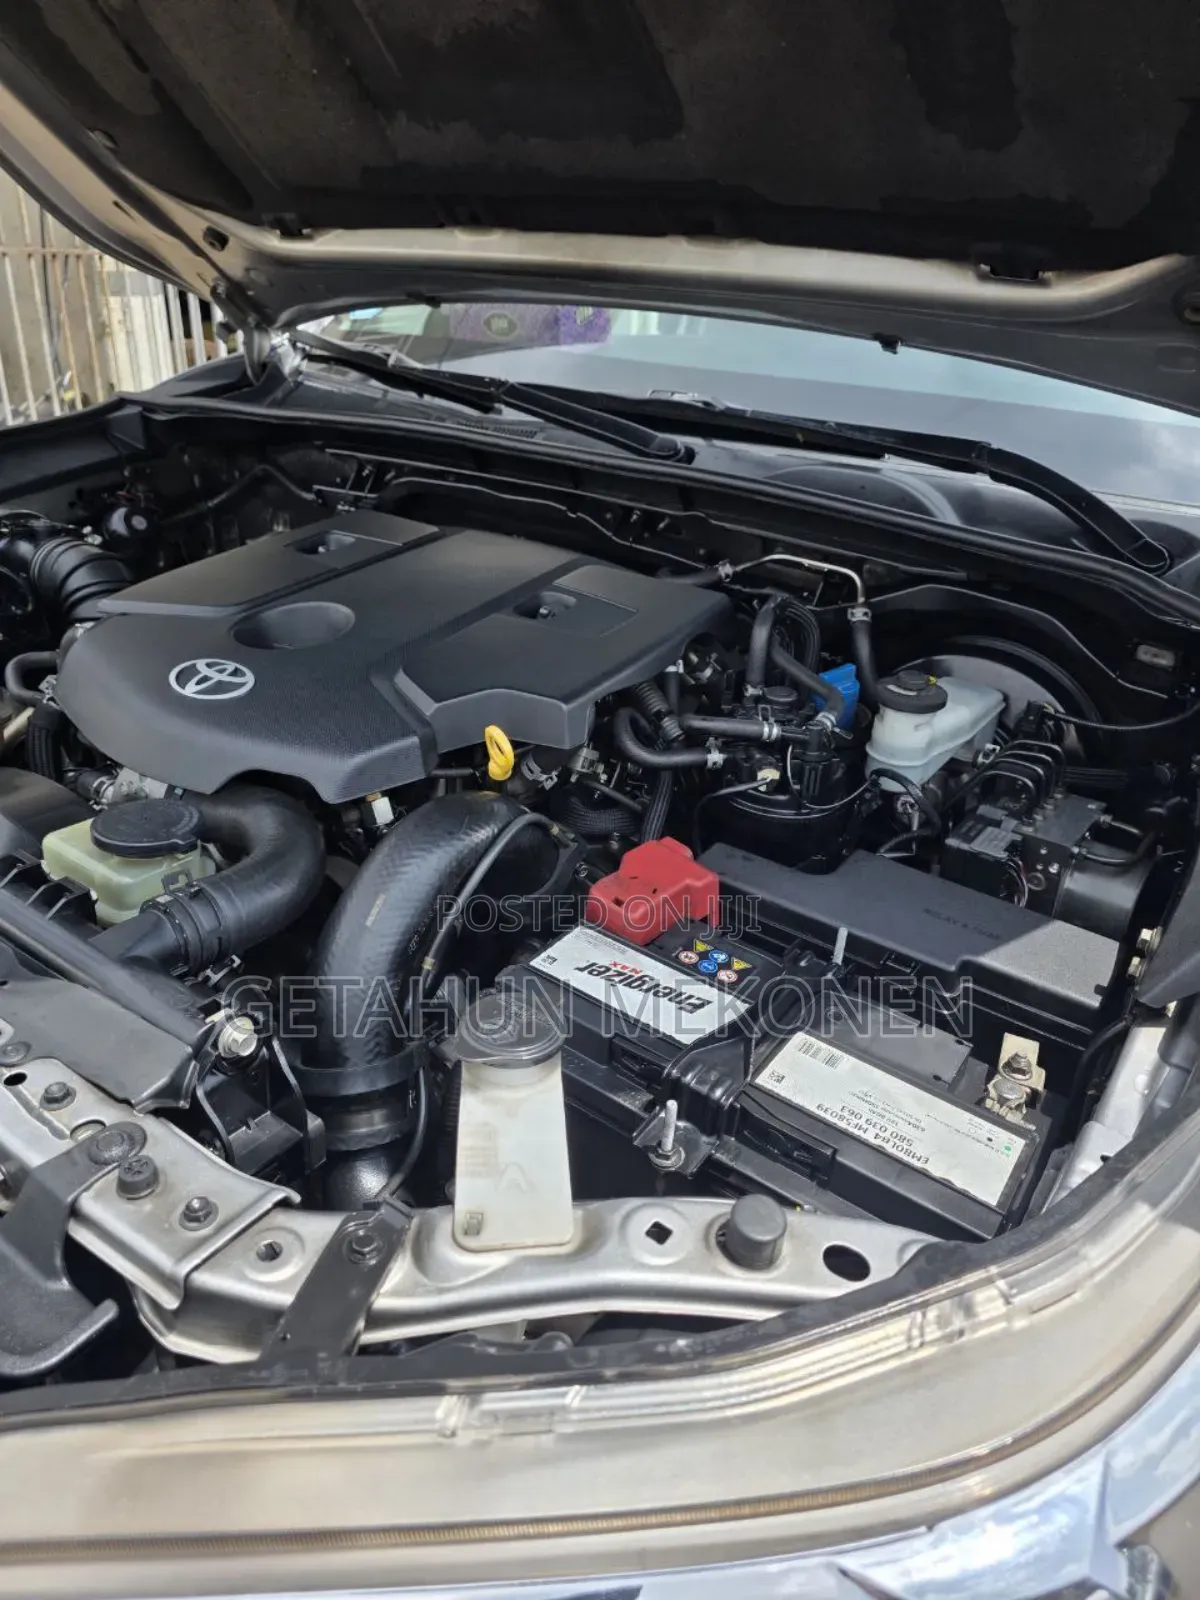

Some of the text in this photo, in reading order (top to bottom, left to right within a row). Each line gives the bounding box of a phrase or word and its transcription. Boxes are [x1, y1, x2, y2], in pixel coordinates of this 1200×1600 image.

[608, 960, 643, 974] MAX
[574, 961, 713, 1014] Energizer
[840, 1105, 863, 1120] 063
[864, 1117, 888, 1133] 039
[889, 1130, 914, 1147] 580
